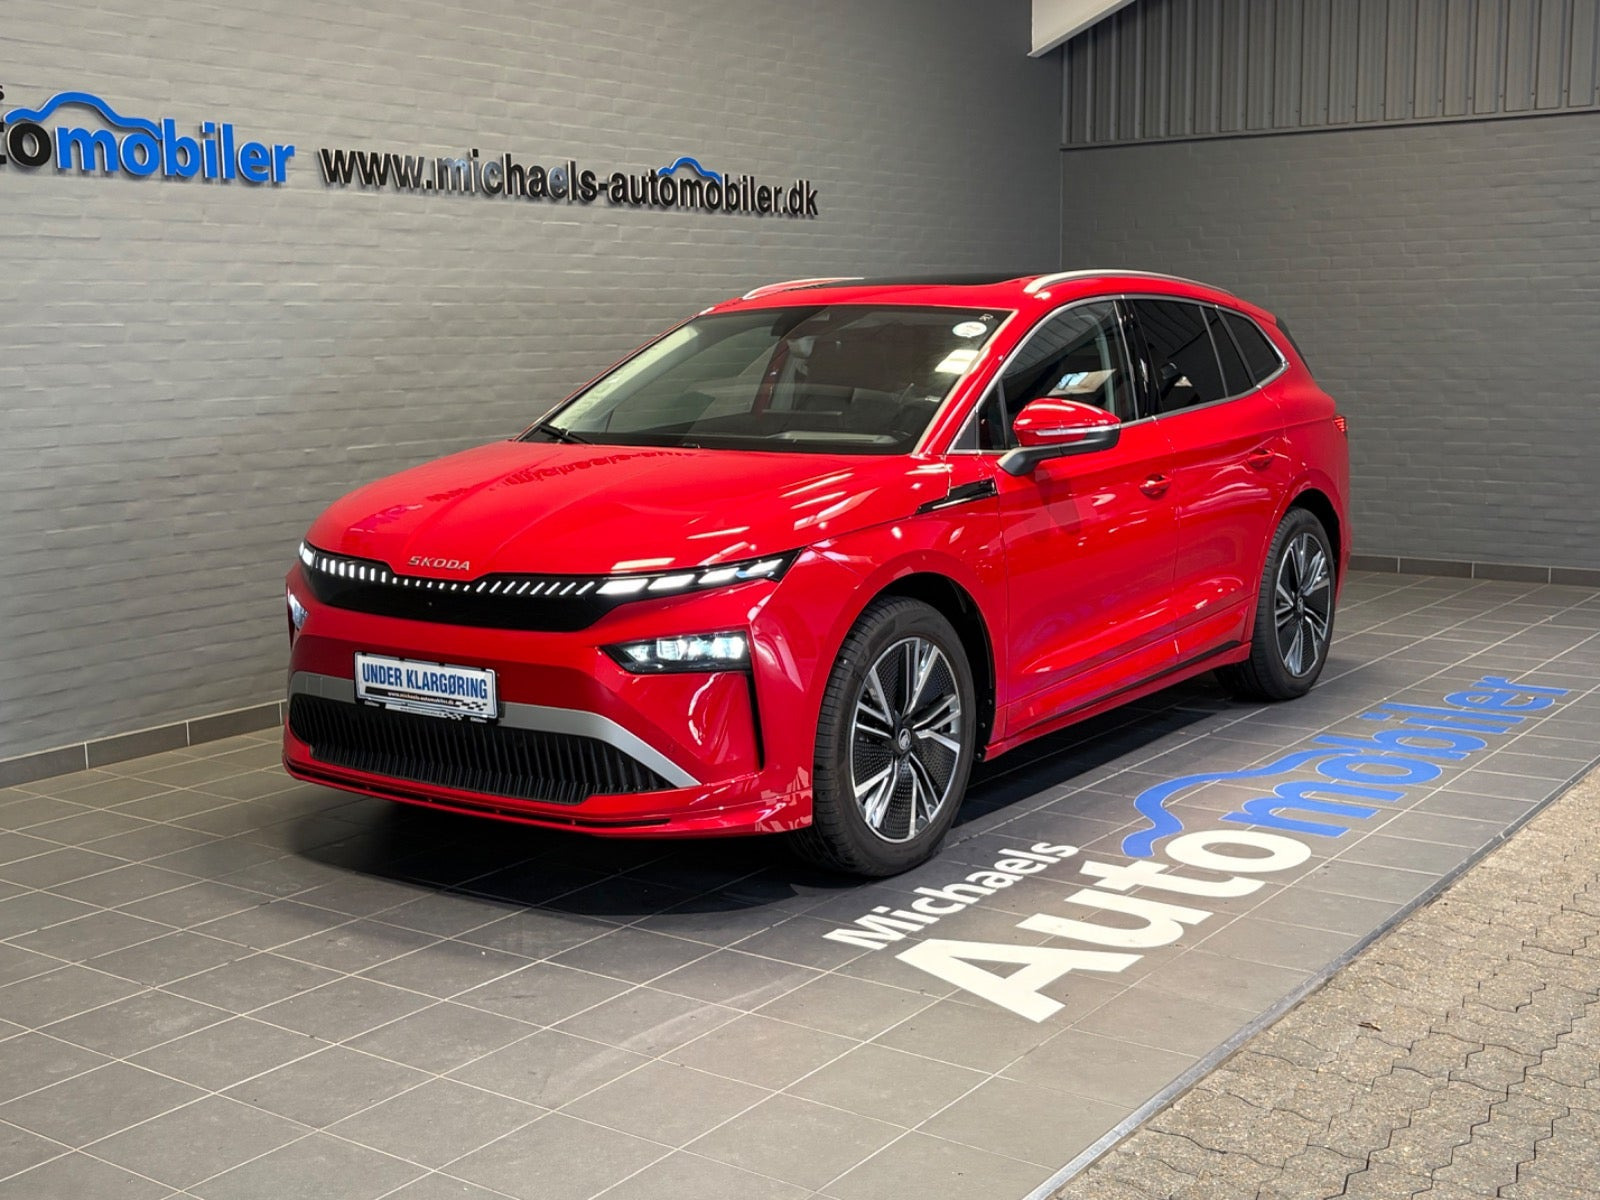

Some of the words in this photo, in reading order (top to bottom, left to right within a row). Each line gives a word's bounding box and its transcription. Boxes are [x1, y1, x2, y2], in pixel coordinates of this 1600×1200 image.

[0, 118, 295, 184] omobiler
[318, 147, 819, 217] www.michaels-automobiler.dk
[362, 662, 403, 688] UNDER
[406, 669, 488, 700] KLARGØRING
[895, 676, 1570, 1023] Automobiler
[822, 842, 1079, 950] Michaels
